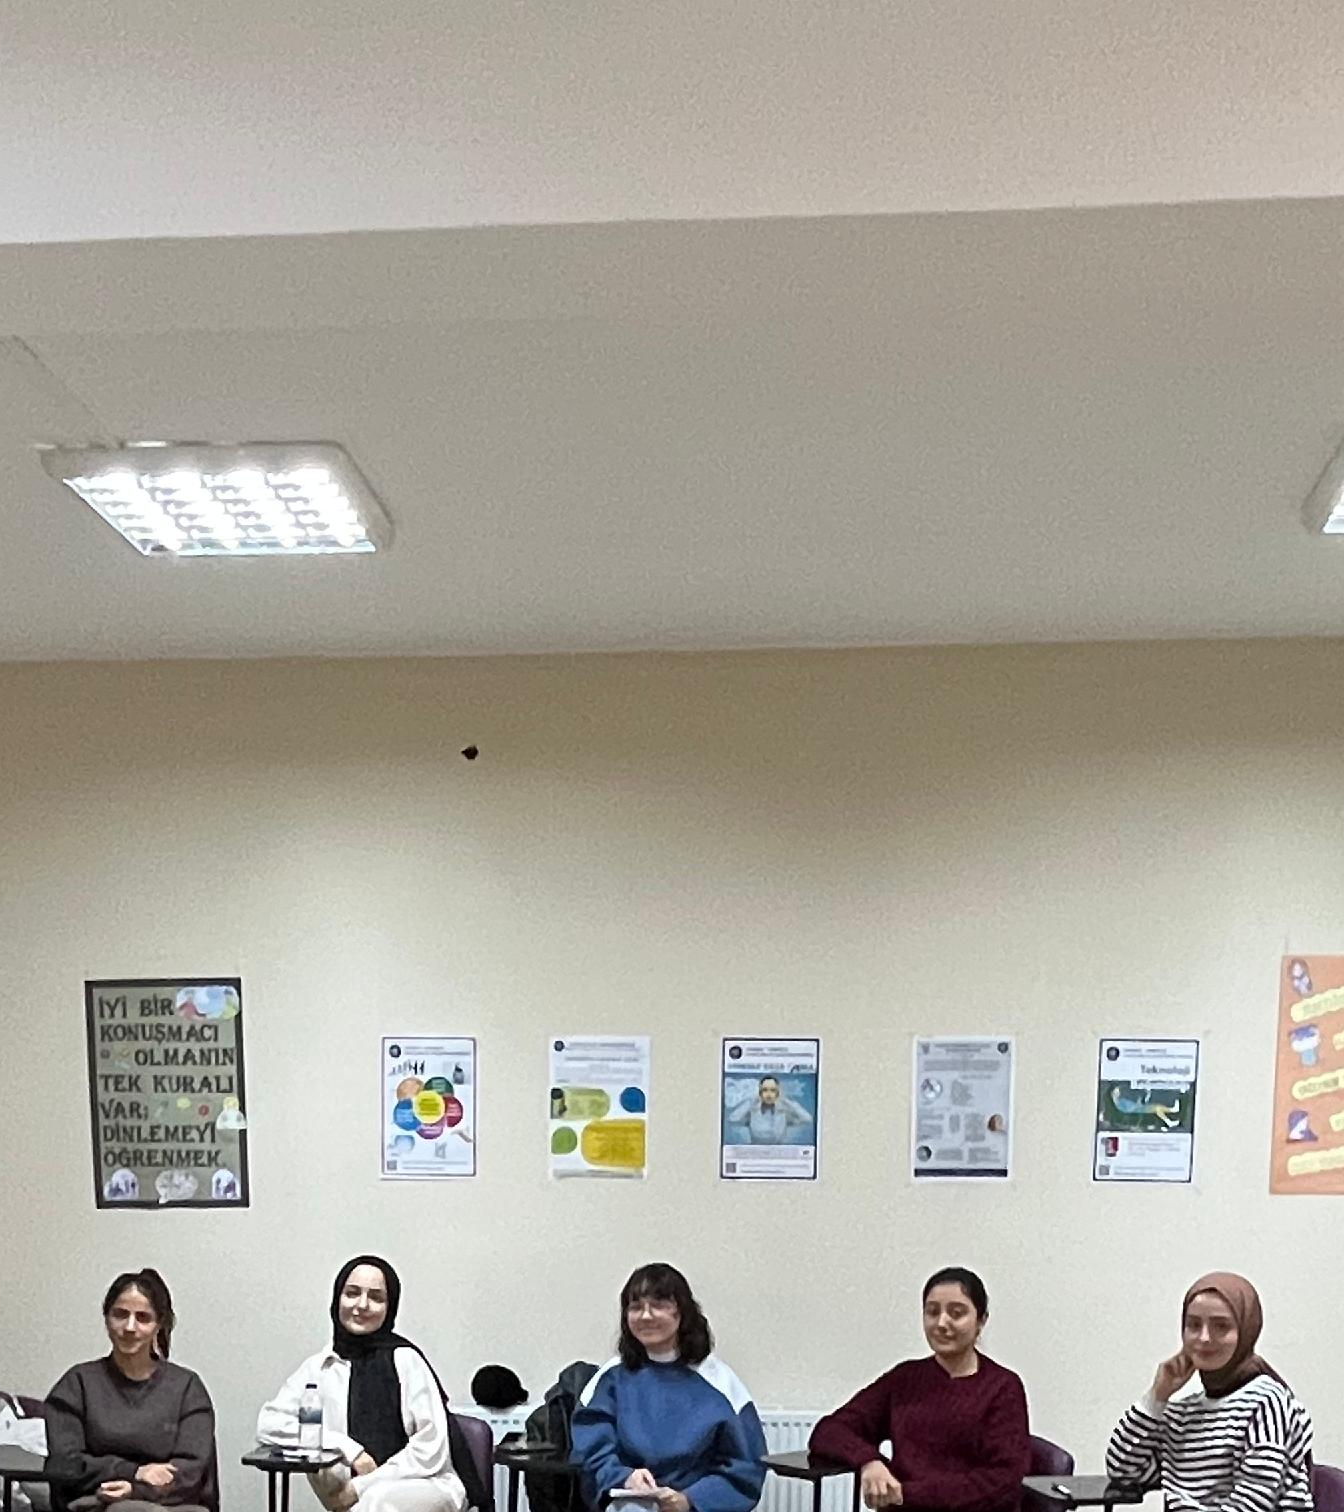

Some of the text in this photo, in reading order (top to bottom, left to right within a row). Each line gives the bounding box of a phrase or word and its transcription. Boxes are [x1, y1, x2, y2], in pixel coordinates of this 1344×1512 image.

[98, 993, 175, 1019] İYİ BİR
[99, 1024, 219, 1044] KONUŞMACI
[134, 1047, 235, 1066] OLMANIN
[98, 1074, 235, 1094] TEK KURALI
[103, 1121, 217, 1144] DİNLEMEYİ
